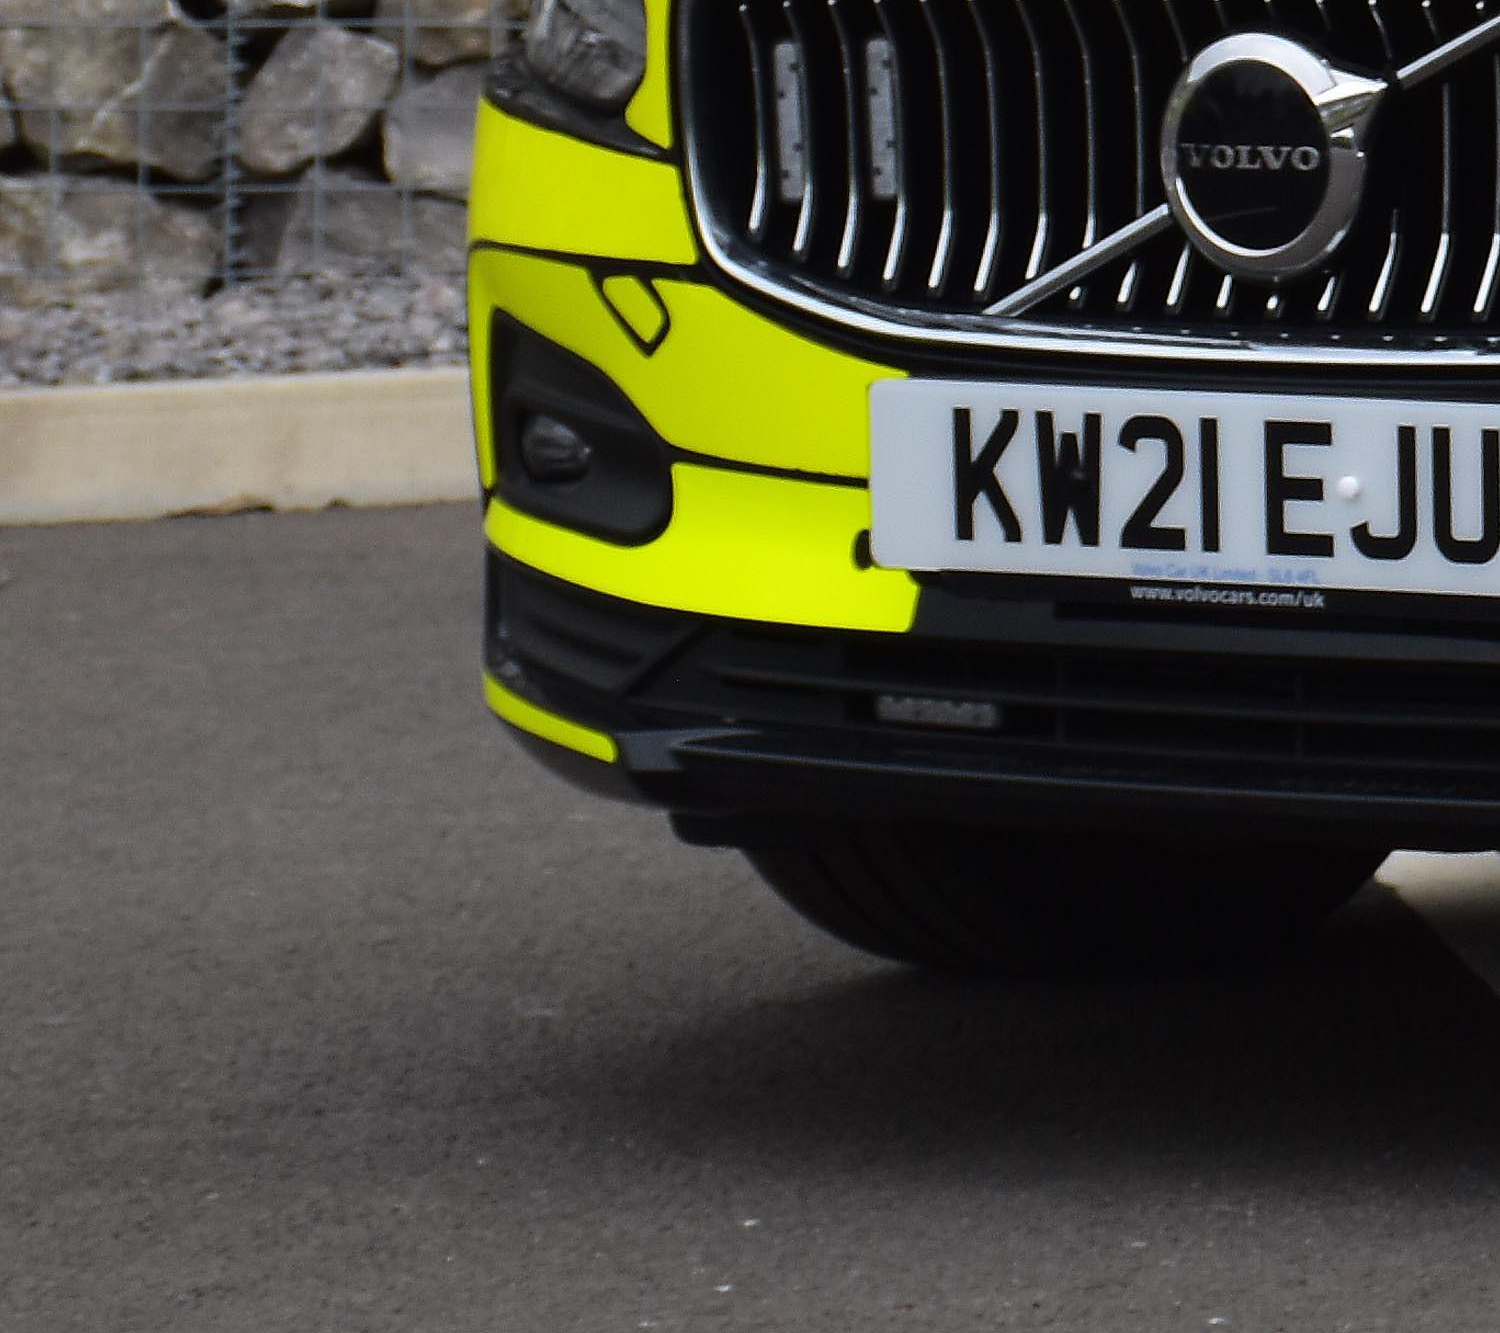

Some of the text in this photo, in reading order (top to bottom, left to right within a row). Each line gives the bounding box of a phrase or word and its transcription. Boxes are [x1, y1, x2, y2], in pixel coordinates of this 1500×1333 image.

[1180, 143, 1321, 171] VOLVO
[951, 405, 1221, 552] KW21
[1129, 583, 1325, 609] www.volvocars.com/uk
